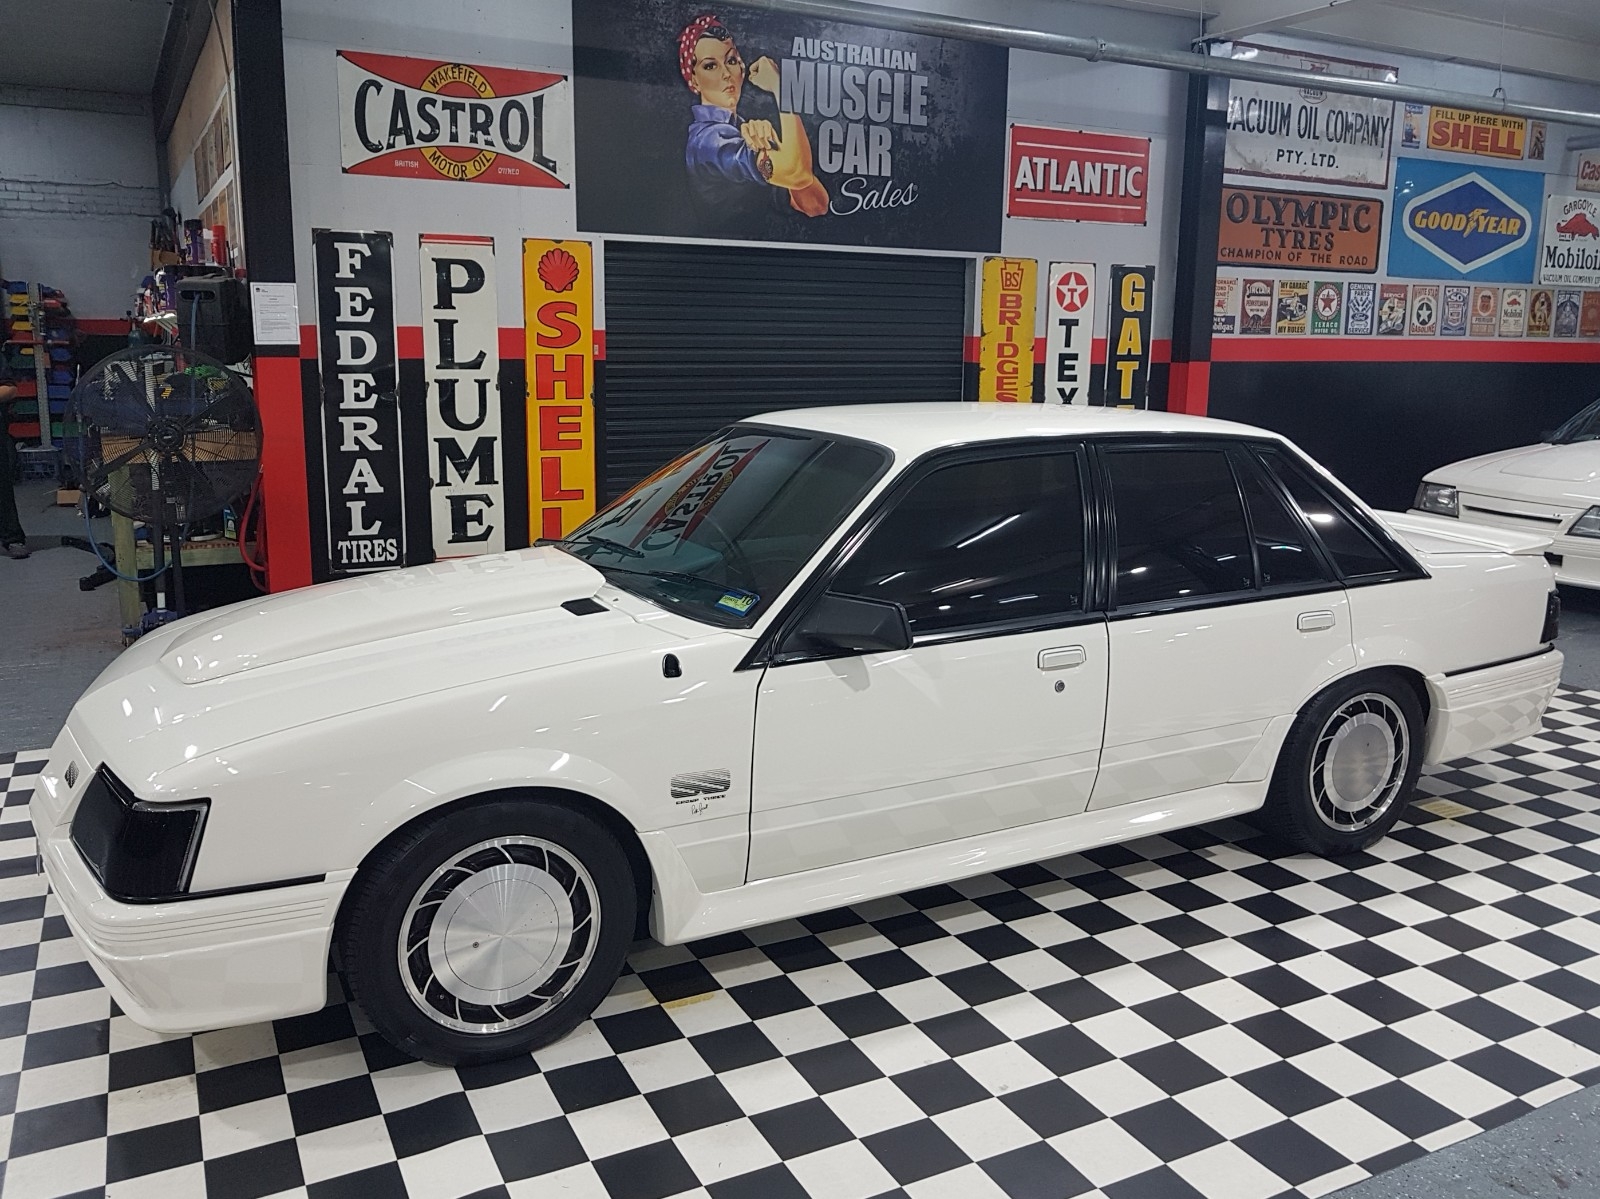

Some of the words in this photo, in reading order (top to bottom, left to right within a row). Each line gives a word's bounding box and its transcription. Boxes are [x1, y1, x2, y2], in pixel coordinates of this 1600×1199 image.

[791, 36, 917, 72] AUSTRALIAN
[428, 67, 487, 94] WAKEFIELD
[780, 58, 928, 127] MUSCLE
[354, 78, 557, 175] CASTROL
[1297, 105, 1320, 140] OIL
[1326, 109, 1390, 148] COMPANY
[1435, 109, 1455, 121] FILL
[1458, 113, 1470, 123] UP
[1473, 116, 1498, 127] HERE
[1501, 119, 1524, 131] WITH
[818, 119, 893, 177] CAR
[1432, 121, 1522, 157] SHELL
[394, 159, 419, 169] BRITISH
[428, 153, 468, 178] MOTOR
[472, 151, 492, 172] OIL
[498, 167, 520, 176] OWNED
[1276, 149, 1307, 166] PTY.
[1311, 152, 1339, 169] LTD.
[1014, 155, 1143, 198] ATLANTIC
[829, 177, 919, 216] Sales
[1564, 199, 1597, 217] GARGOYLE
[1226, 192, 1371, 233] OLYMPIC
[1261, 227, 1335, 251] TYRES
[1220, 247, 1282, 261] CHAMPION
[1288, 252, 1302, 262] OF
[1310, 253, 1332, 264] THE
[1339, 255, 1369, 266] ROAD
[1004, 271, 1020, 287] BS
[333, 242, 384, 536] FEDERAL
[431, 257, 499, 544] PLUME
[338, 538, 398, 564] TIRES
